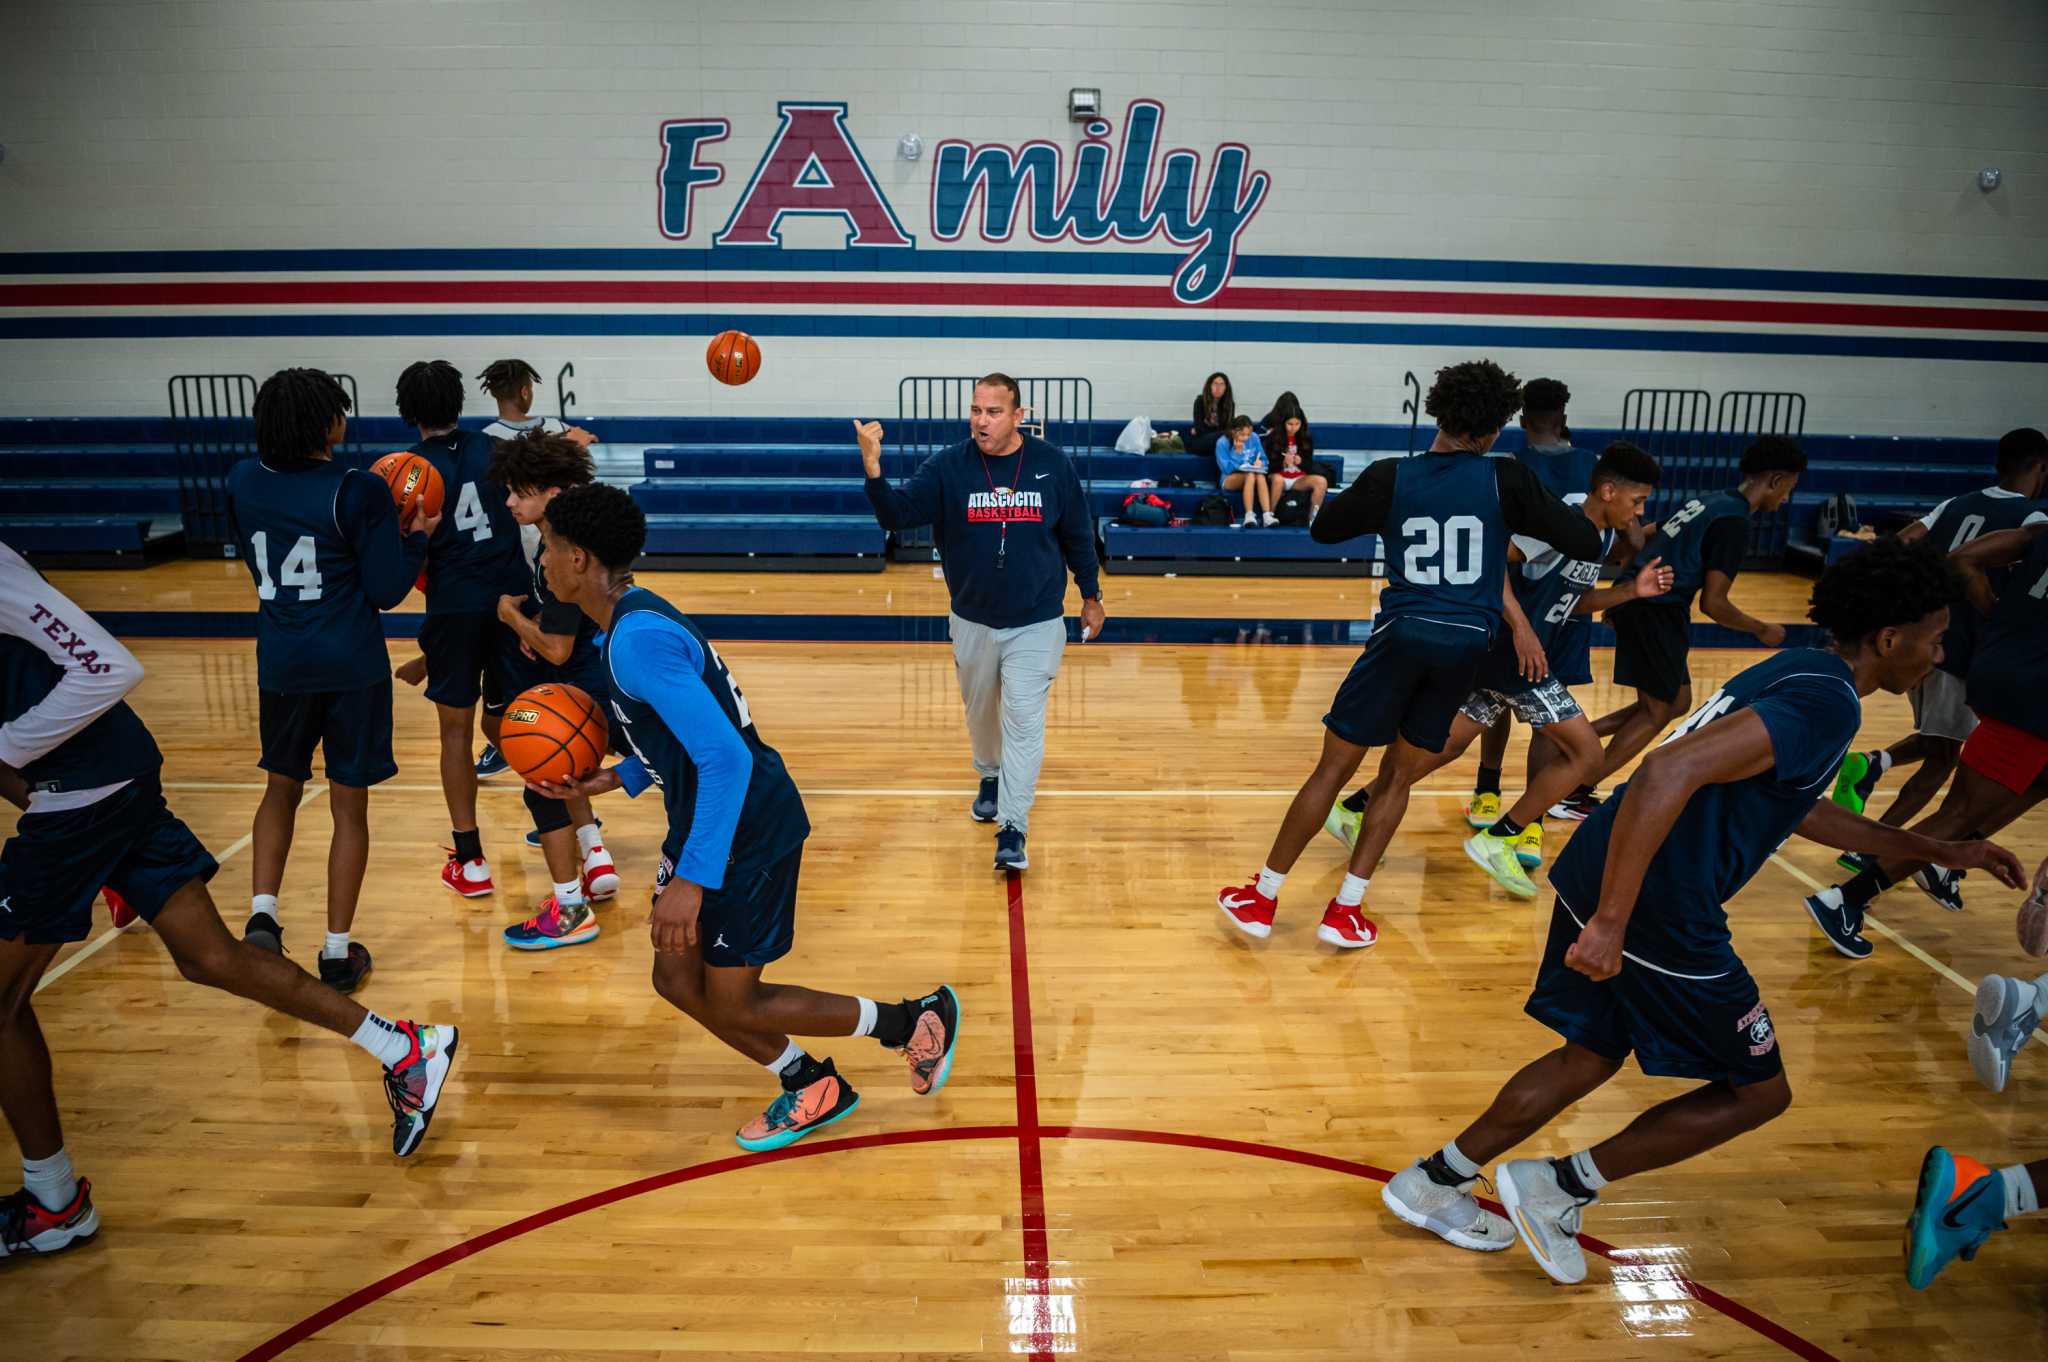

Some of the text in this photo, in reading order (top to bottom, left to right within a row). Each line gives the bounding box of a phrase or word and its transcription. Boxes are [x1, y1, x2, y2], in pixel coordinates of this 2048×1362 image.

[454, 481, 493, 542] 4
[967, 507, 1043, 519] BASKETBALL
[968, 491, 1043, 508] ATASCOCITA
[251, 531, 323, 601] 14
[1402, 515, 1484, 585] 20
[29, 603, 110, 674] TEXAS
